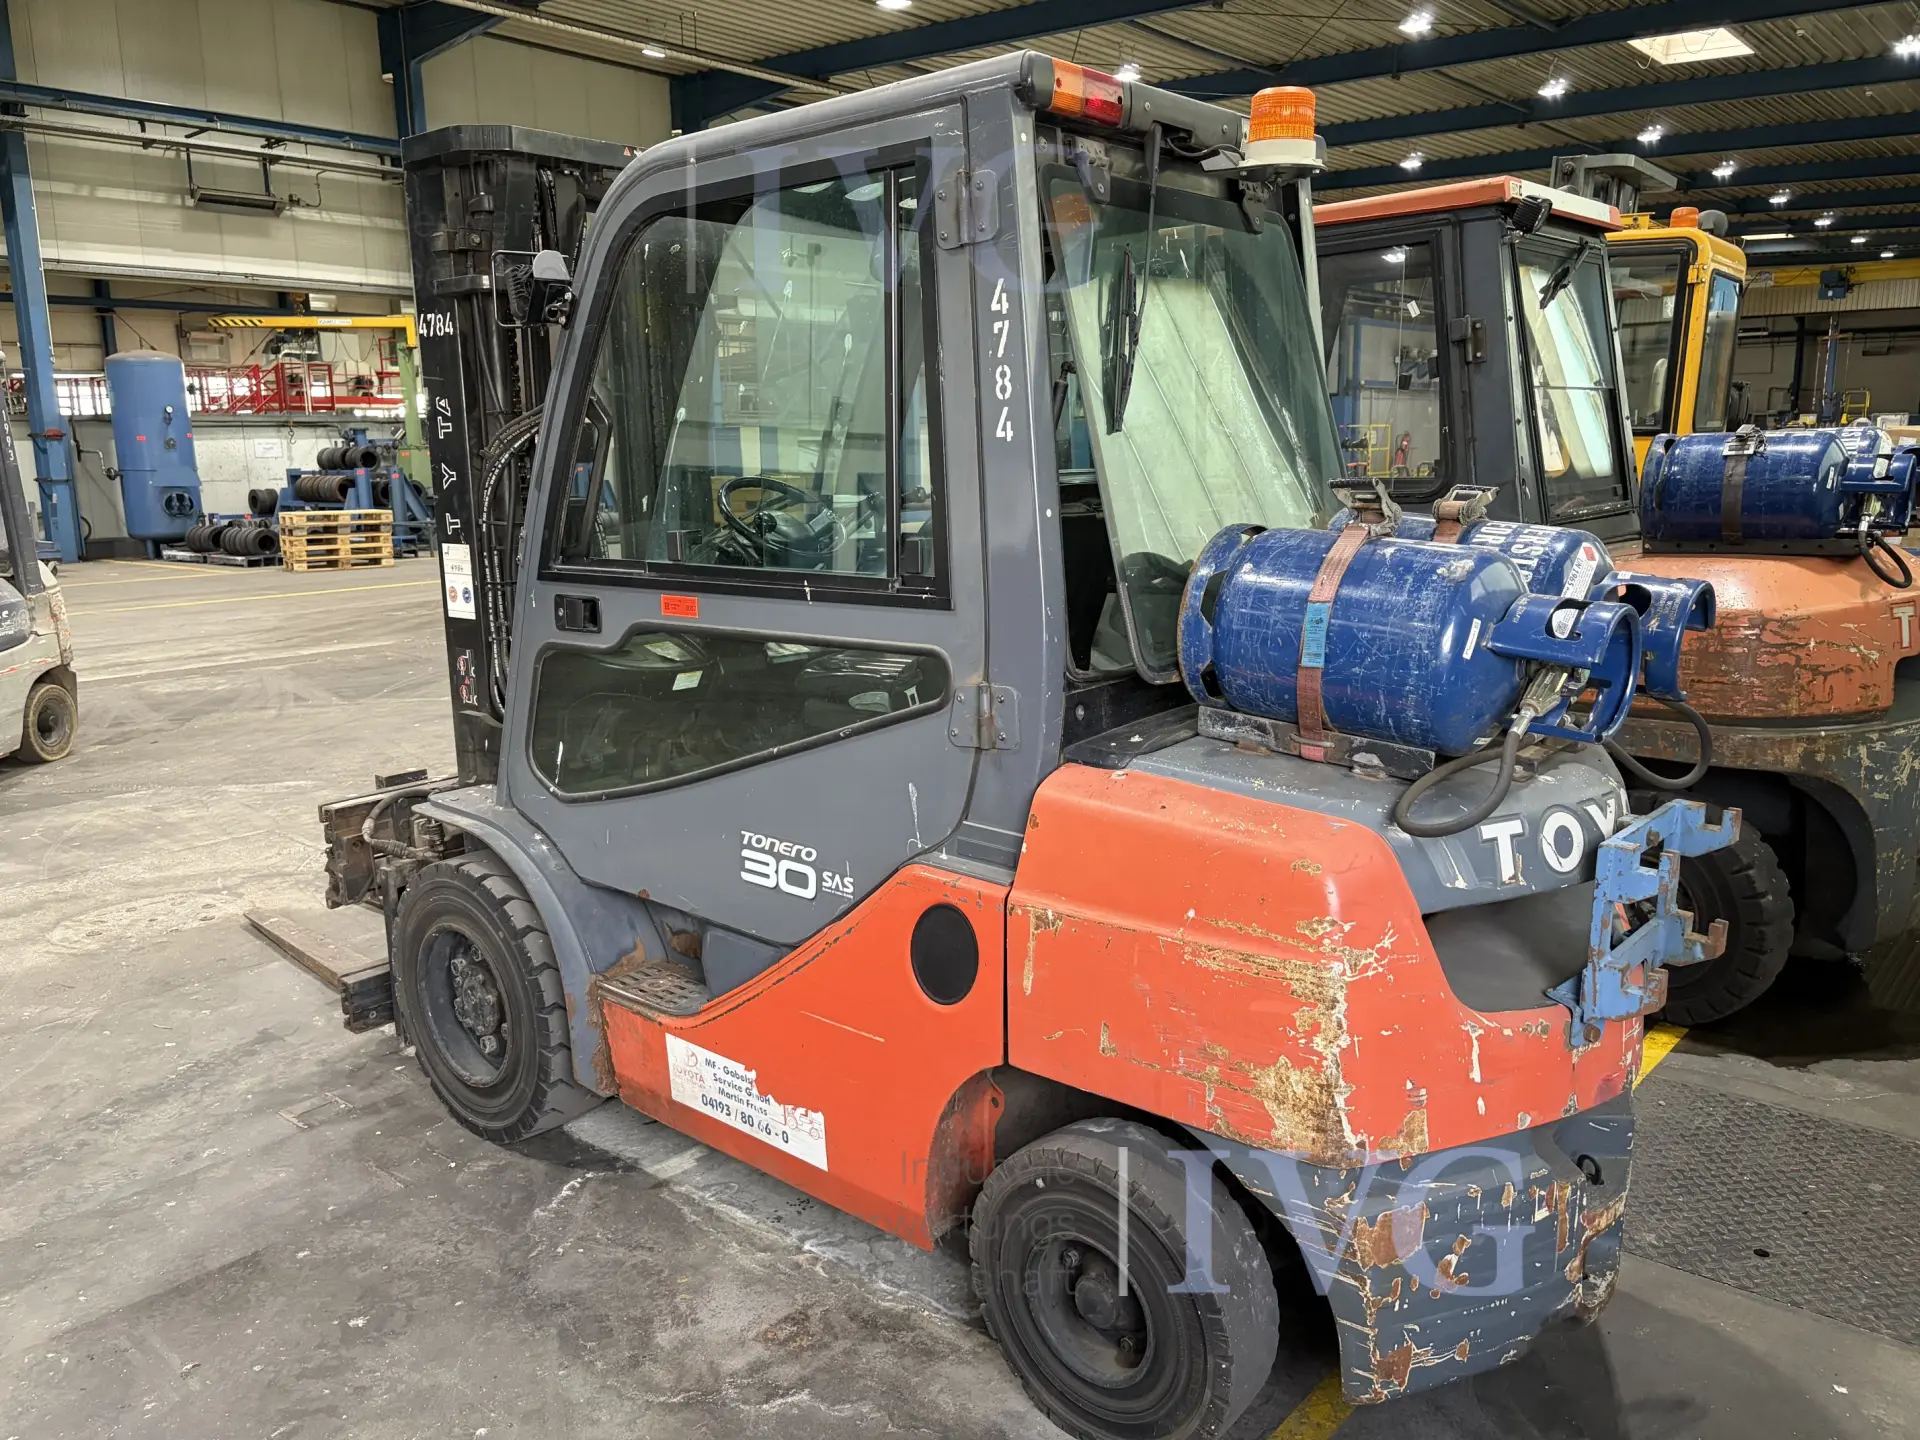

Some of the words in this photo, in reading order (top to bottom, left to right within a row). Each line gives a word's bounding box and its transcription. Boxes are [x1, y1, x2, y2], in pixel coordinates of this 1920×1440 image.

[418, 311, 454, 337] 4784
[991, 277, 1013, 442] 4784
[2, 409, 14, 461] 1993
[1567, 568, 1580, 587] 1965
[740, 848, 817, 900] 30
[822, 871, 854, 894] SAS
[704, 1057, 717, 1070] MF
[713, 1073, 743, 1093] Service
[718, 1087, 745, 1105] Martin
[701, 1093, 732, 1117] 04193
[740, 1111, 754, 1127] 80
